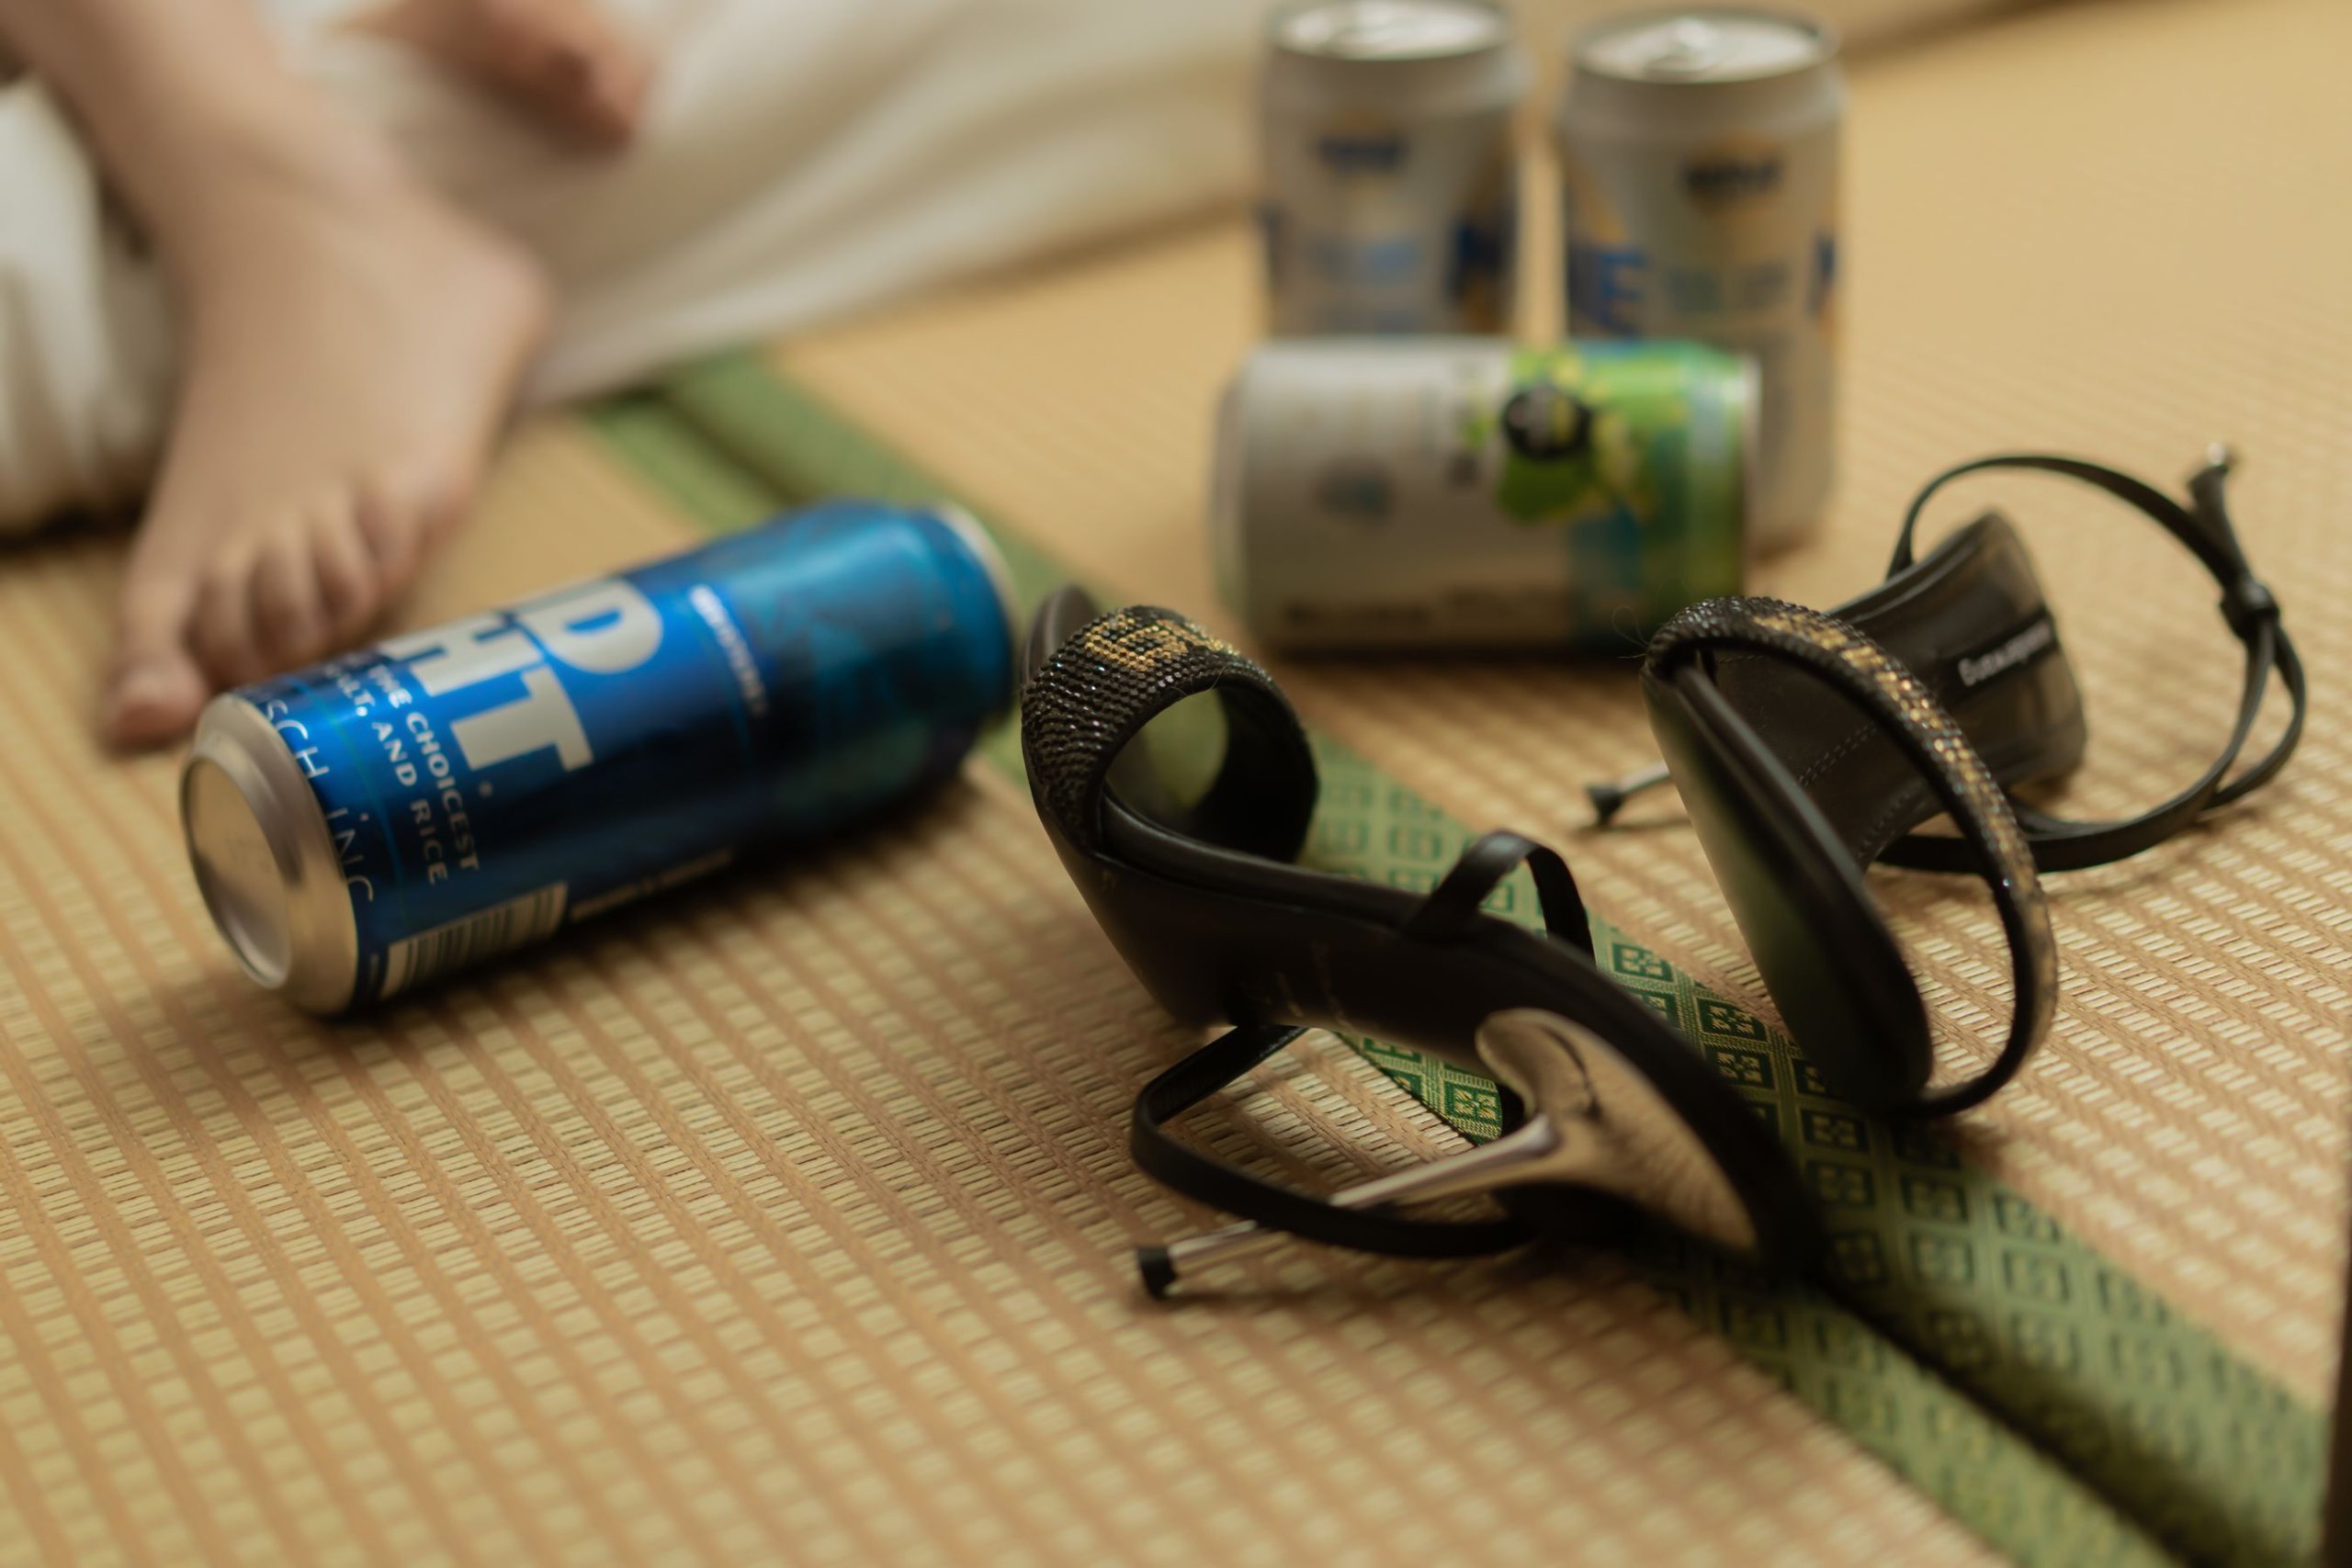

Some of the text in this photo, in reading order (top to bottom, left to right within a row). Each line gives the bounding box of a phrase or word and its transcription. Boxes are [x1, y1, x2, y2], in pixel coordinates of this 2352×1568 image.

[371, 720, 418, 787] AND
[410, 797, 448, 886] RICE
[405, 711, 480, 871] CHOICEST
